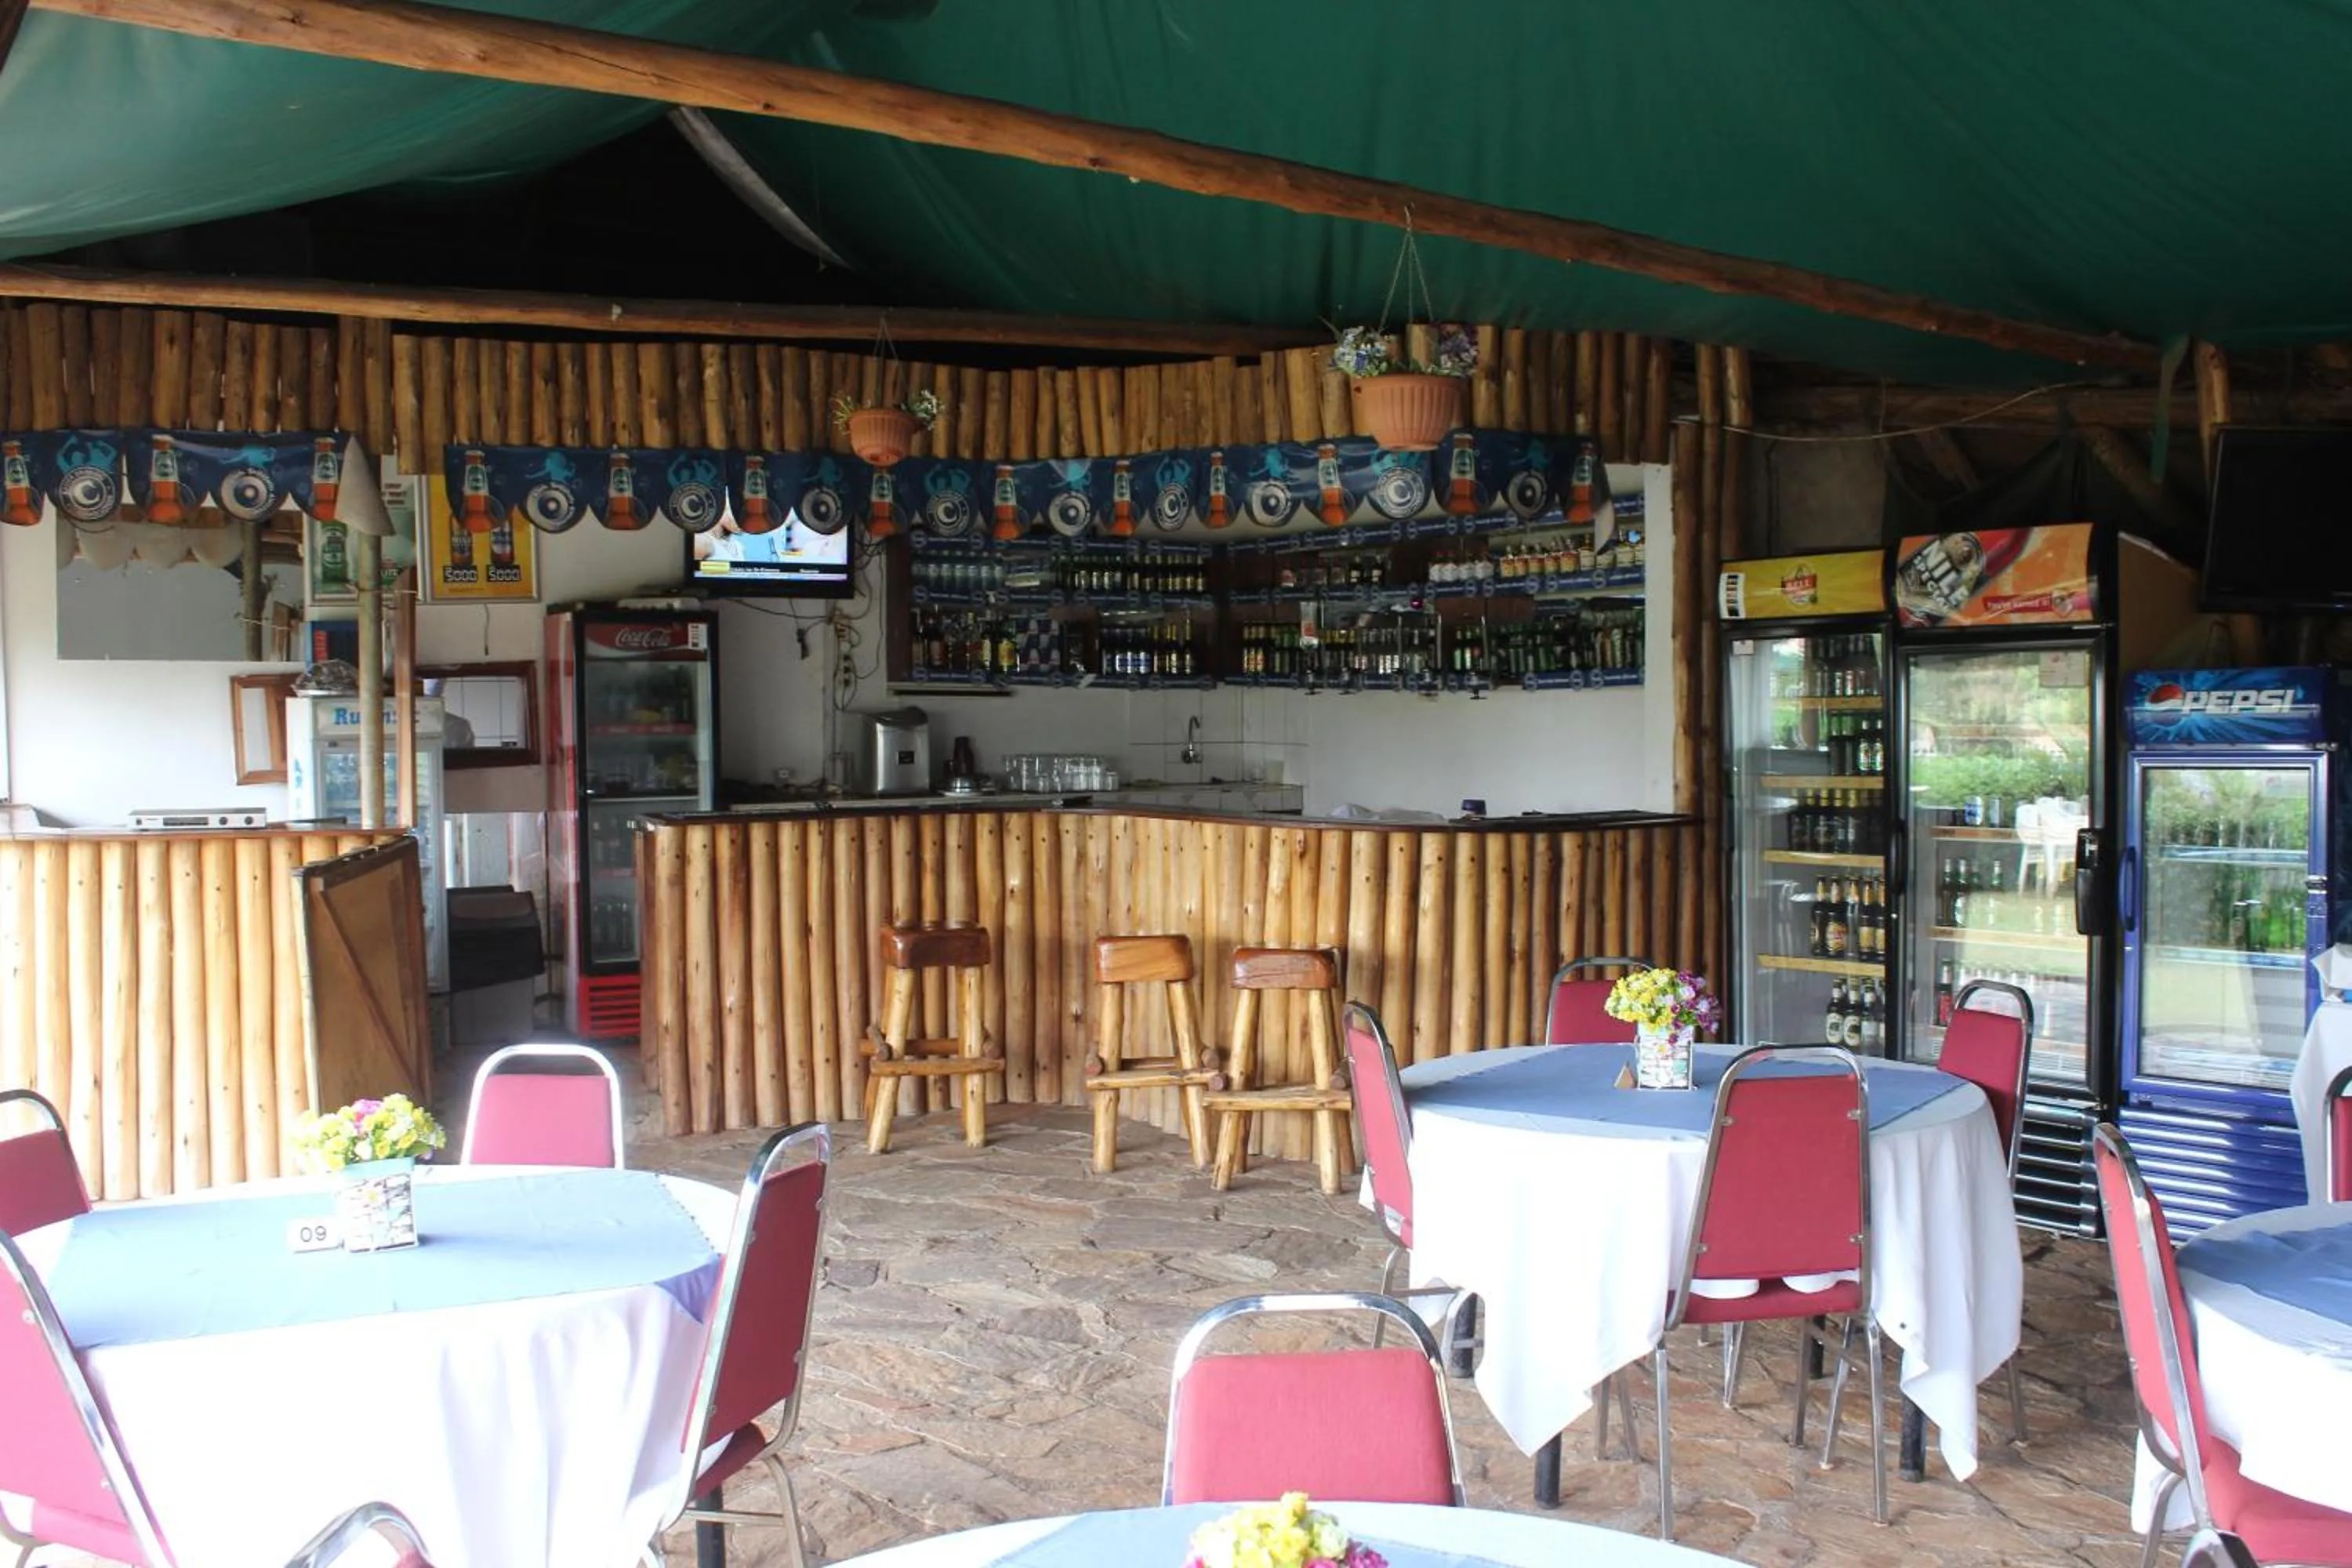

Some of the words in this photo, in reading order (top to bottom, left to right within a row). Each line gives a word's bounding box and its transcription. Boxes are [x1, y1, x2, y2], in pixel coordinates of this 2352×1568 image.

[1922, 539, 1969, 605] NILE
[2183, 689, 2295, 714] PEPSI
[301, 1226, 327, 1243] 09
